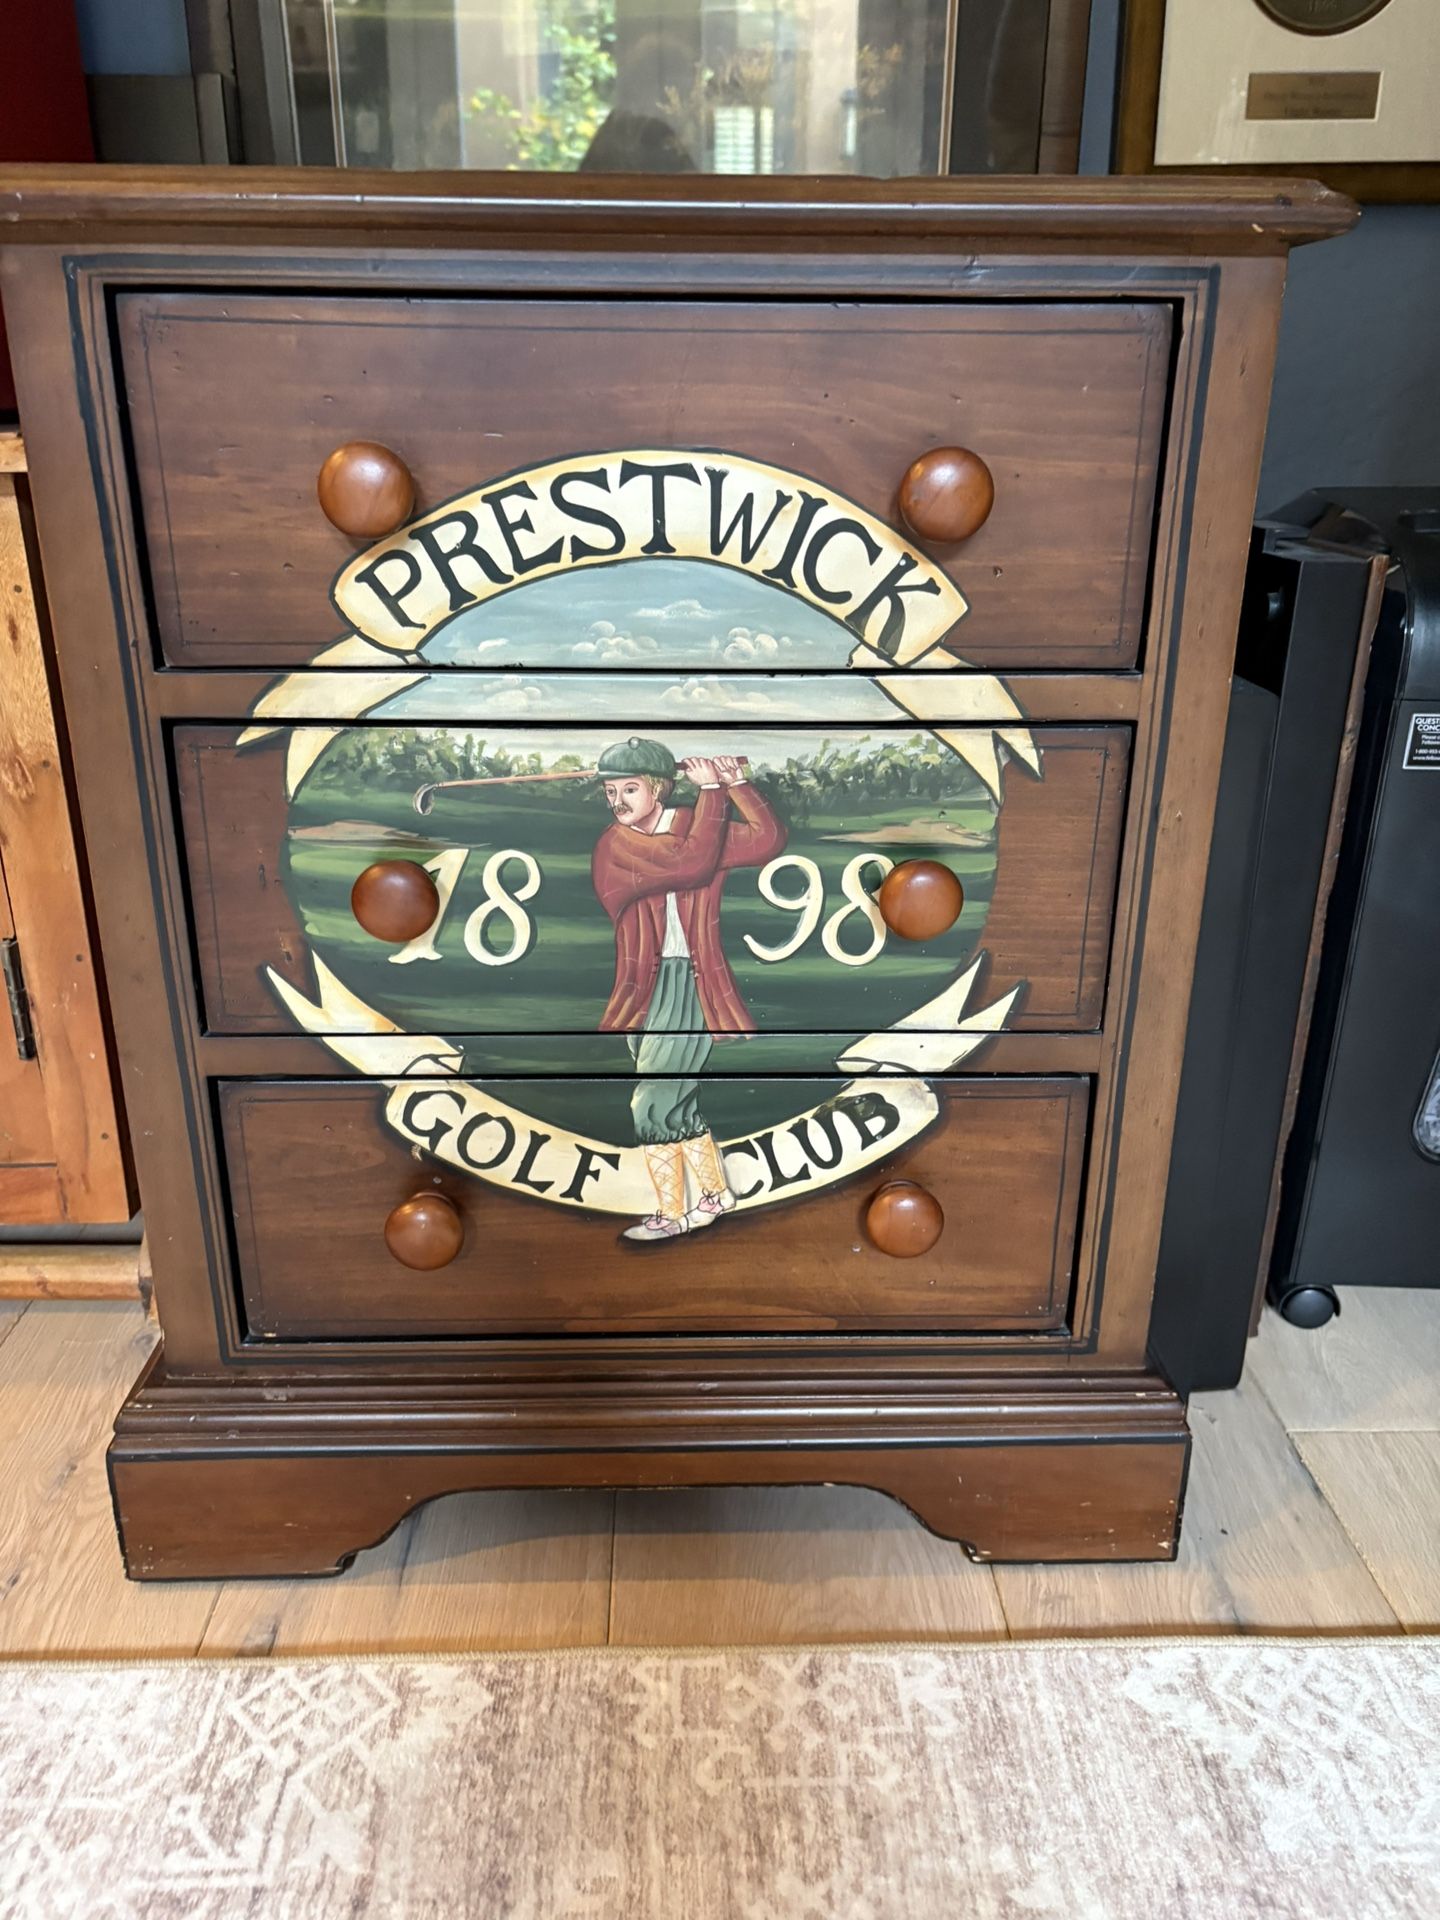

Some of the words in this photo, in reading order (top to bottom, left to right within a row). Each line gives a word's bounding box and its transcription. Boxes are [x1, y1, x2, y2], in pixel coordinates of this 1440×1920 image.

[355, 459, 940, 651] PRESTWICK
[389, 849, 541, 965] 18
[743, 853, 894, 966] 98
[401, 1090, 620, 1202] GOLF
[721, 1092, 901, 1201] CLUB
